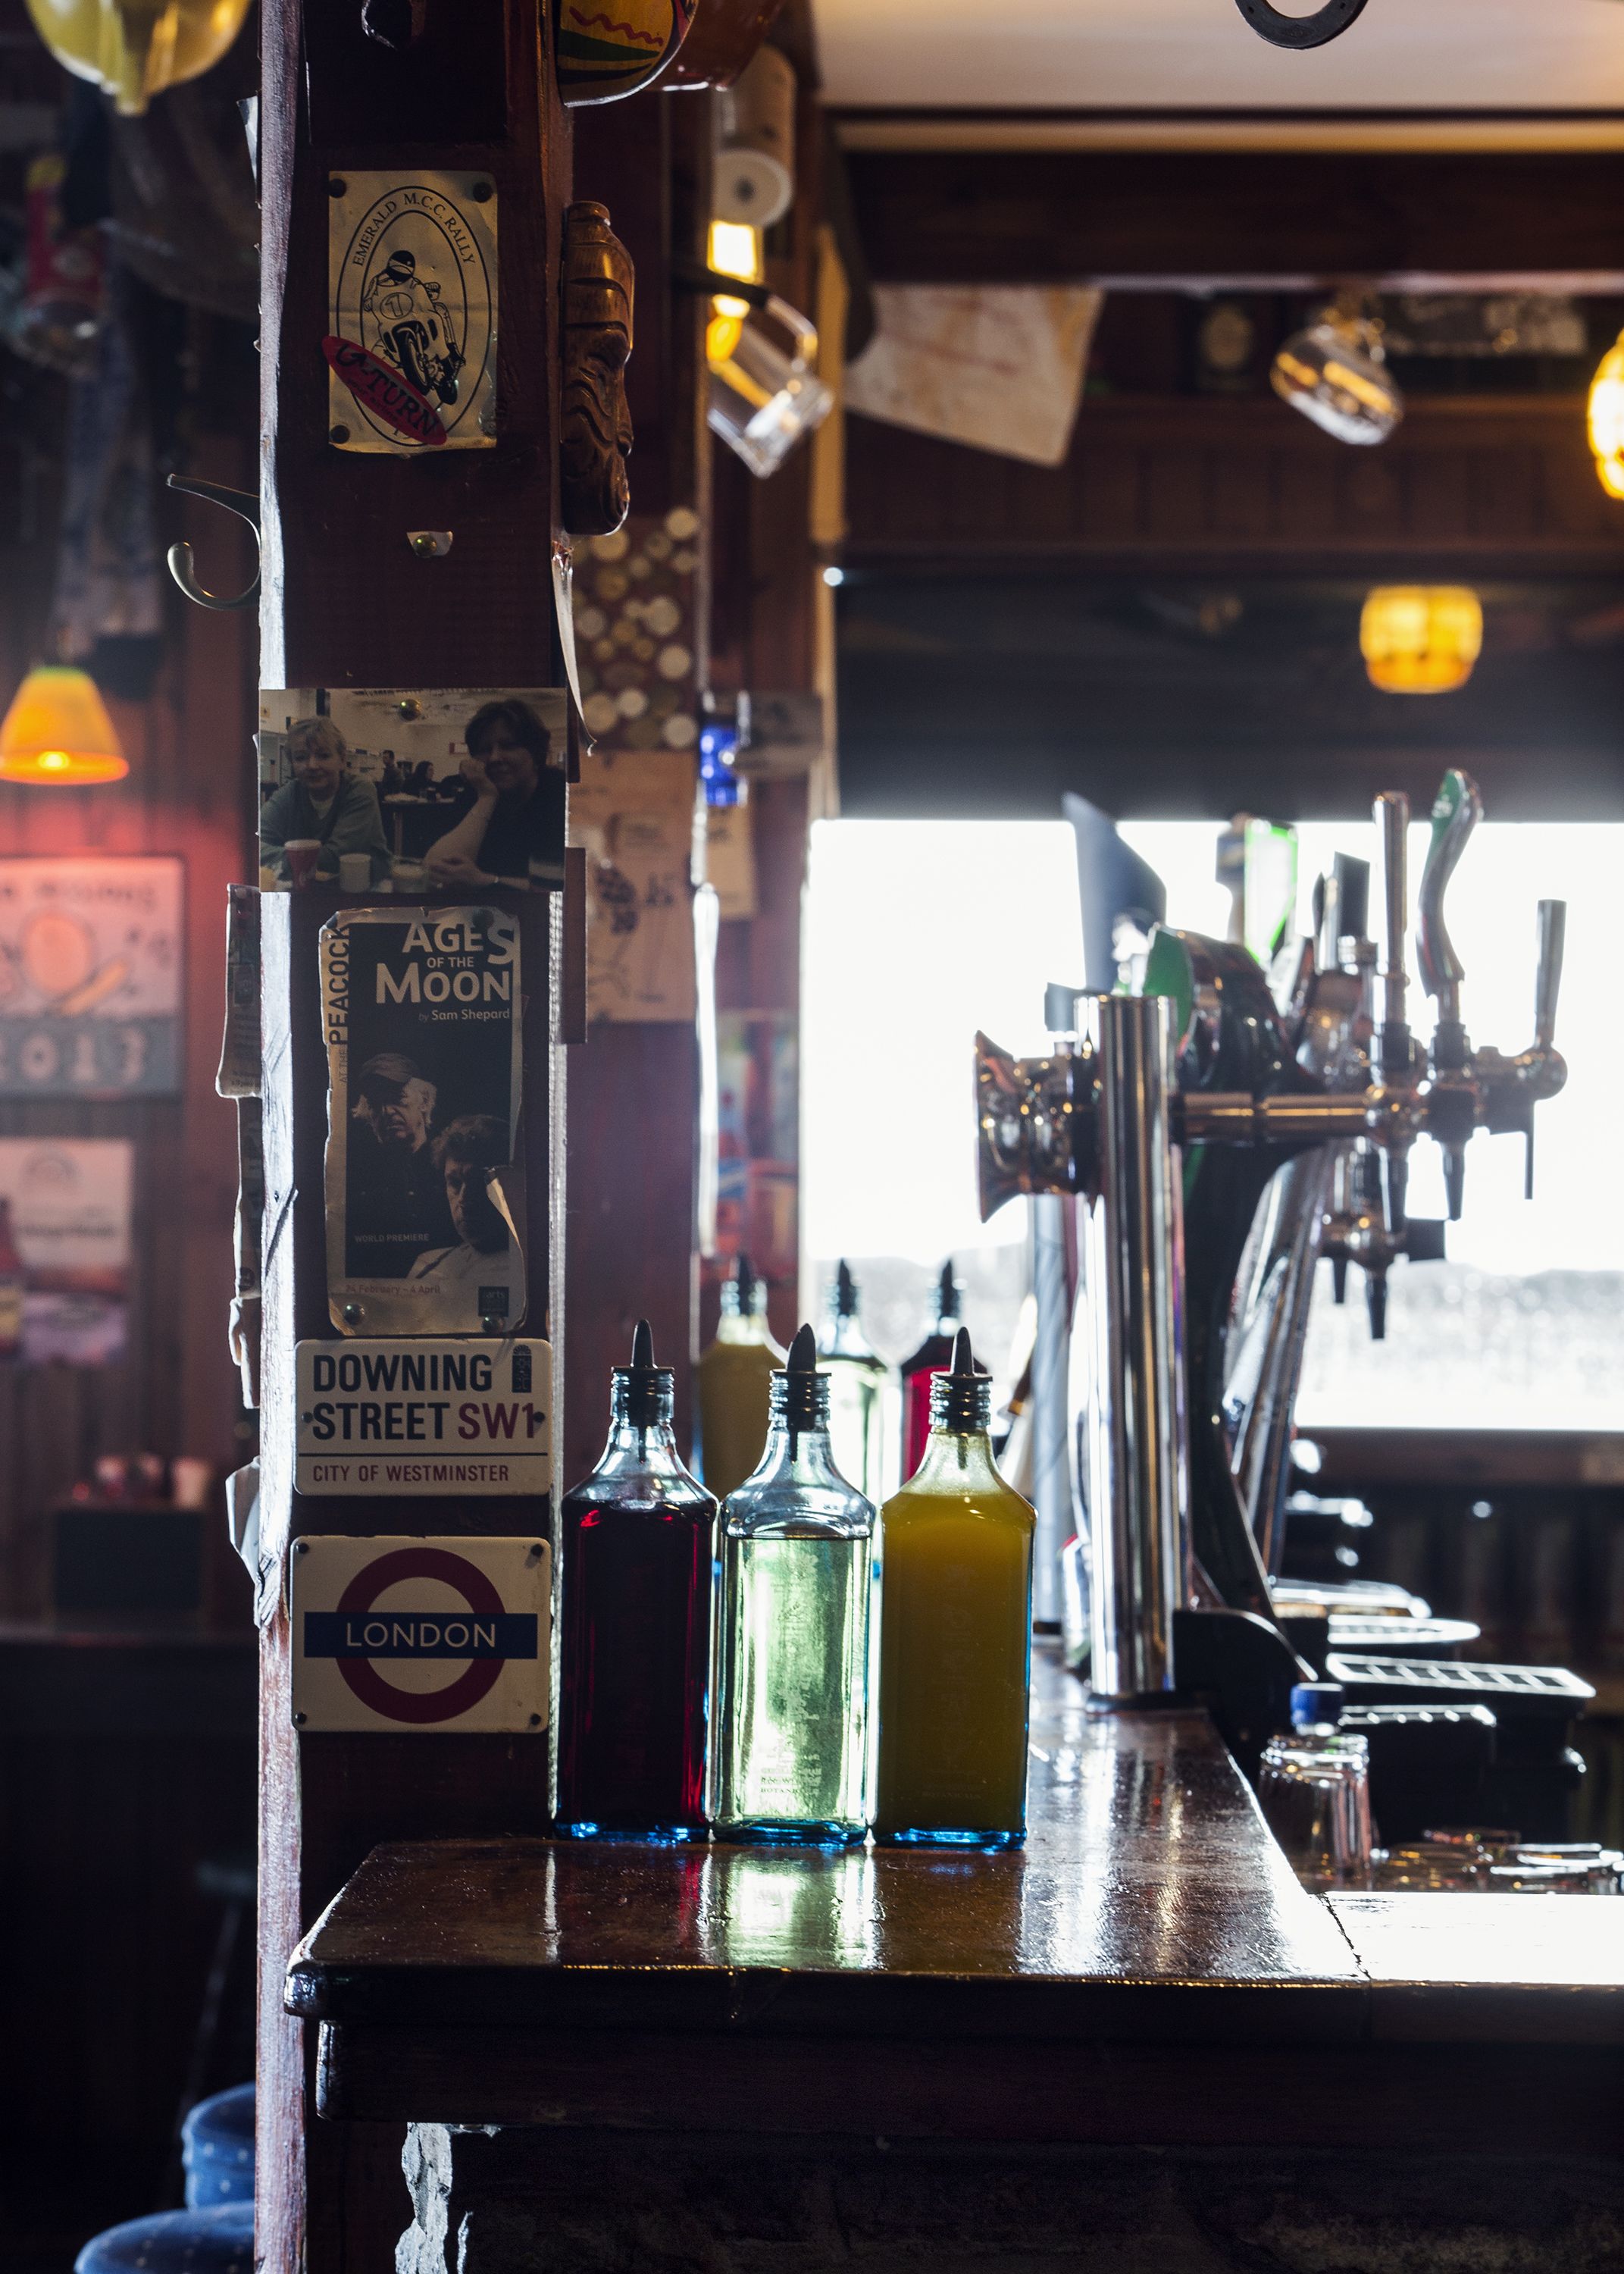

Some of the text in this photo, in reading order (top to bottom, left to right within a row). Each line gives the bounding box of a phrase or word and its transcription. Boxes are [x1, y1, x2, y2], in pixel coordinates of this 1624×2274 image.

[352, 199, 397, 267] EMERALD
[443, 217, 476, 265] RALLY
[402, 922, 515, 965] AGES
[426, 957, 474, 968] OF THE
[327, 926, 350, 1045] PEACOCK
[375, 962, 511, 1004] MOON
[418, 1008, 510, 1023] by Sam Shepard
[354, 1233, 430, 1243] WORLD PREMIERE
[359, 1284, 400, 1295] February
[418, 1284, 441, 1294] April
[313, 1355, 492, 1392] DOWNING
[312, 1402, 535, 1440] STREET SW1
[313, 1465, 509, 1482] CITY OF WESTMINSTER
[346, 1622, 496, 1648] LONDON
